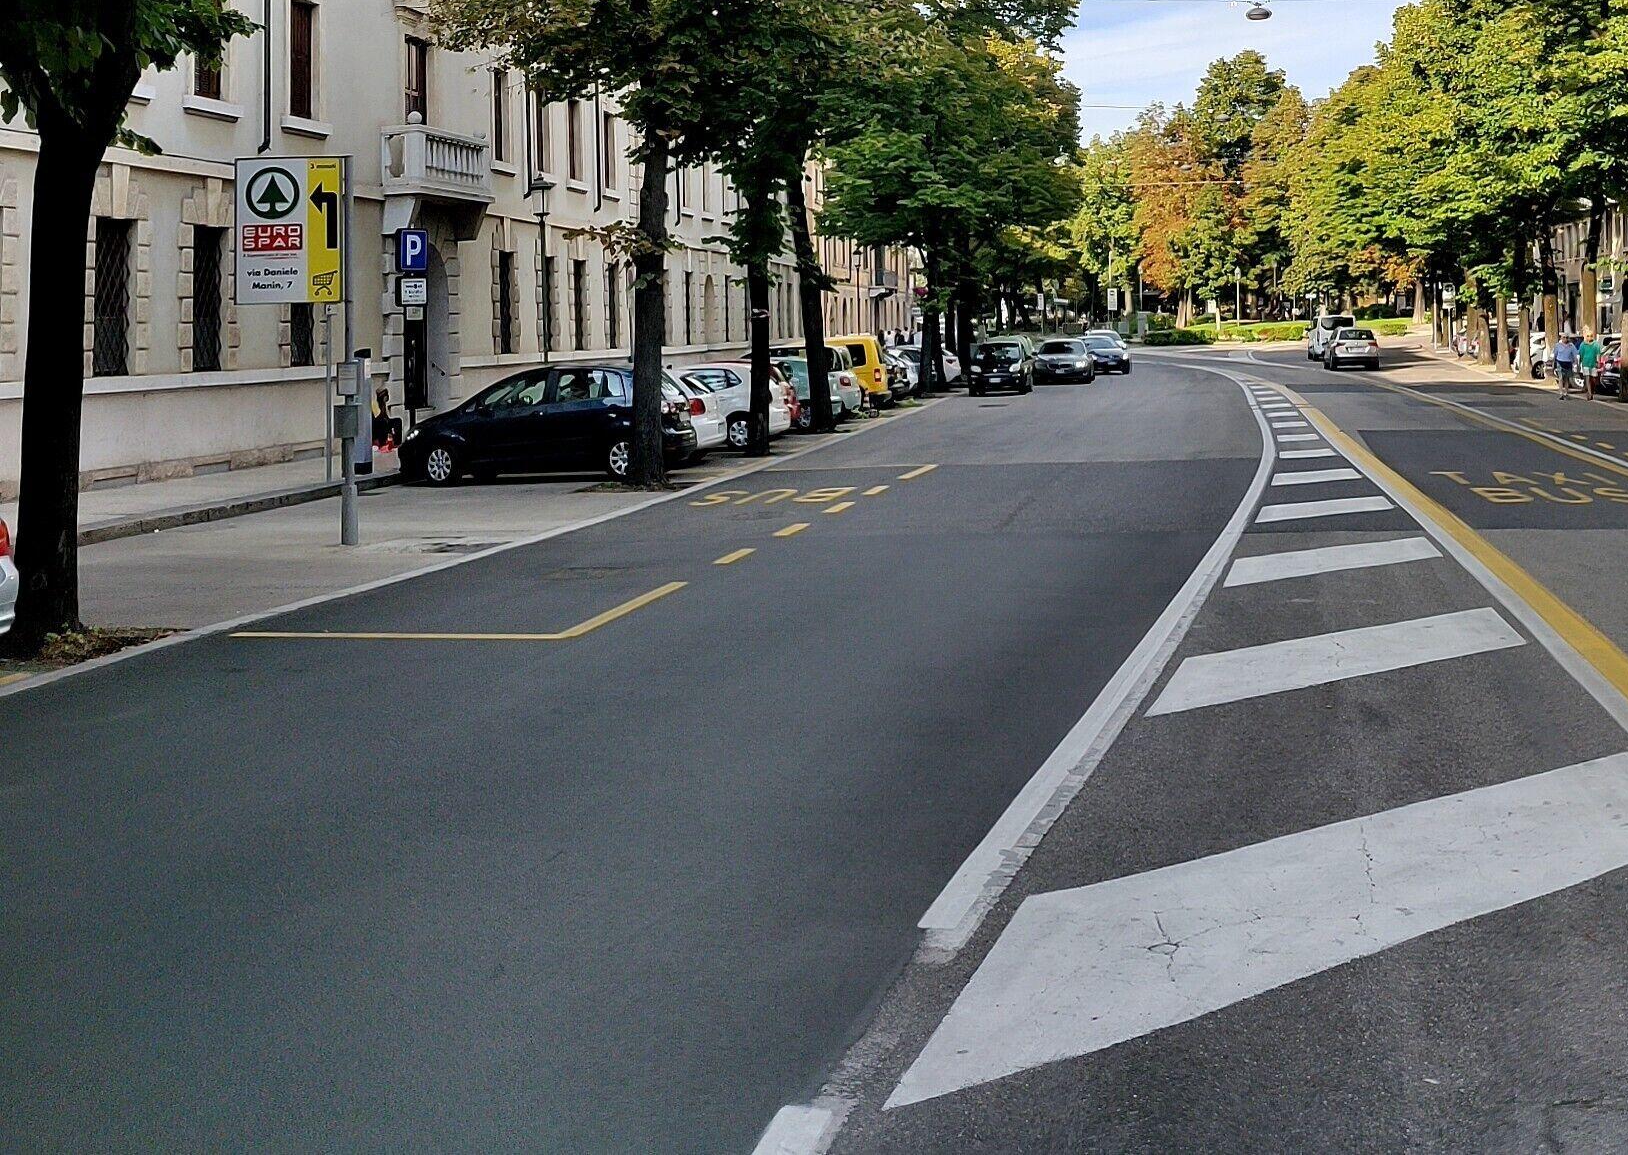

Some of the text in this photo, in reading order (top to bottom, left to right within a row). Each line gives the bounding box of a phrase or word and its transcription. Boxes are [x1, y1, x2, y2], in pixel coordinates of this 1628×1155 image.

[243, 226, 301, 238] EURO
[243, 237, 301, 249] SPAR
[406, 234, 422, 266] P
[246, 266, 299, 277] via Daniele
[251, 281, 293, 290] Manin, 7
[1428, 470, 1619, 486] TAXI
[688, 486, 859, 507] BUS
